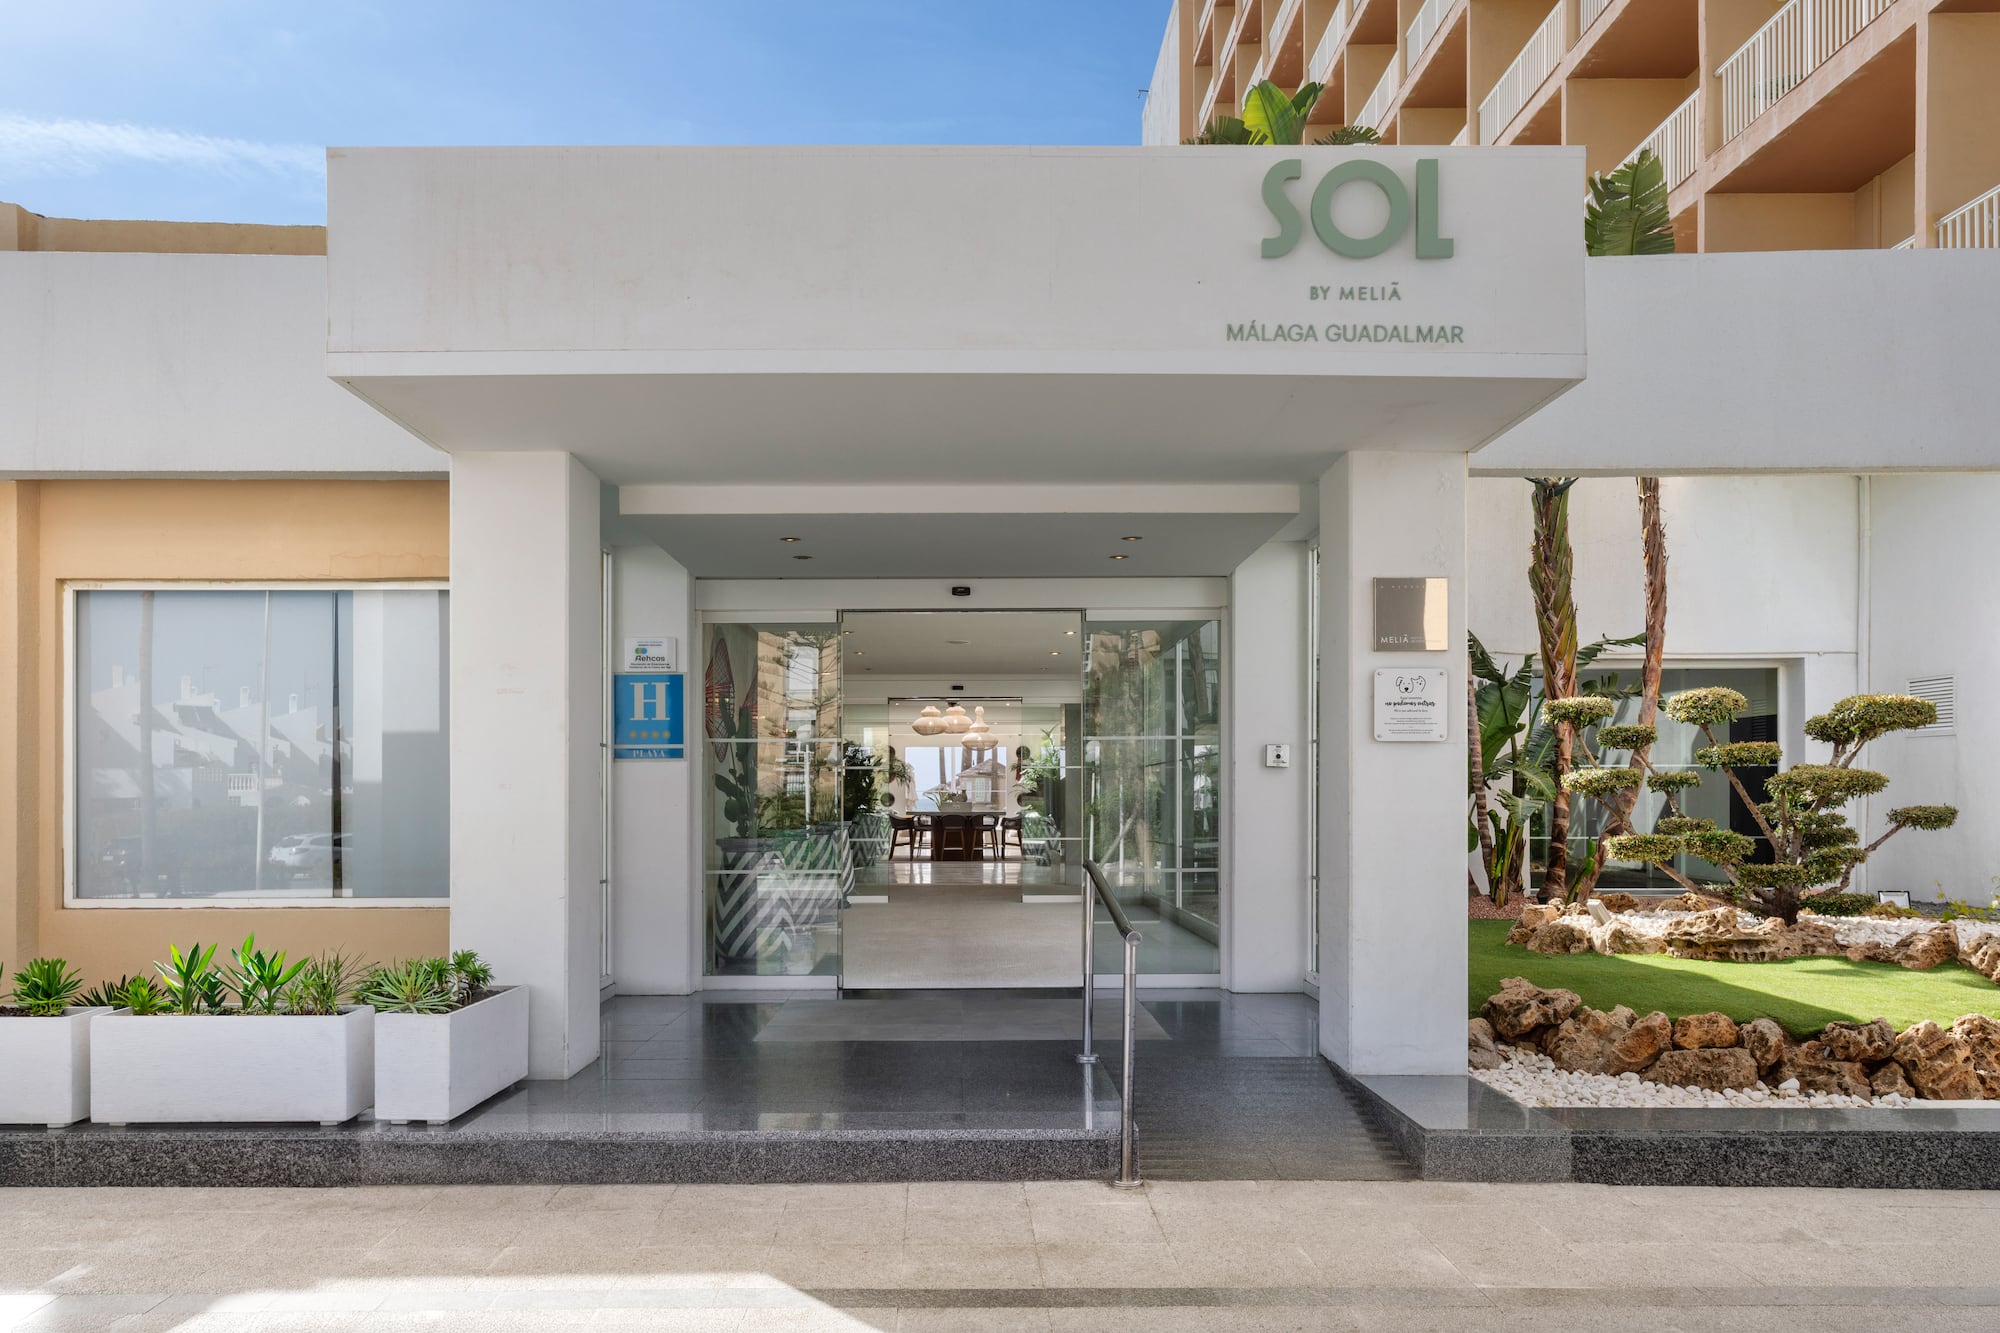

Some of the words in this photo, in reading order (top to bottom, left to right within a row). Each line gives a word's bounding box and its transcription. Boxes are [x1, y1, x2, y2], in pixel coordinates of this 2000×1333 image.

[1261, 158, 1454, 259] SOL
[1309, 286, 1330, 301] BY
[1226, 320, 1318, 342] MÁLAGA
[1325, 323, 1464, 344] GUADALMAR
[629, 682, 671, 721] H
[632, 749, 667, 758] PLAYA
